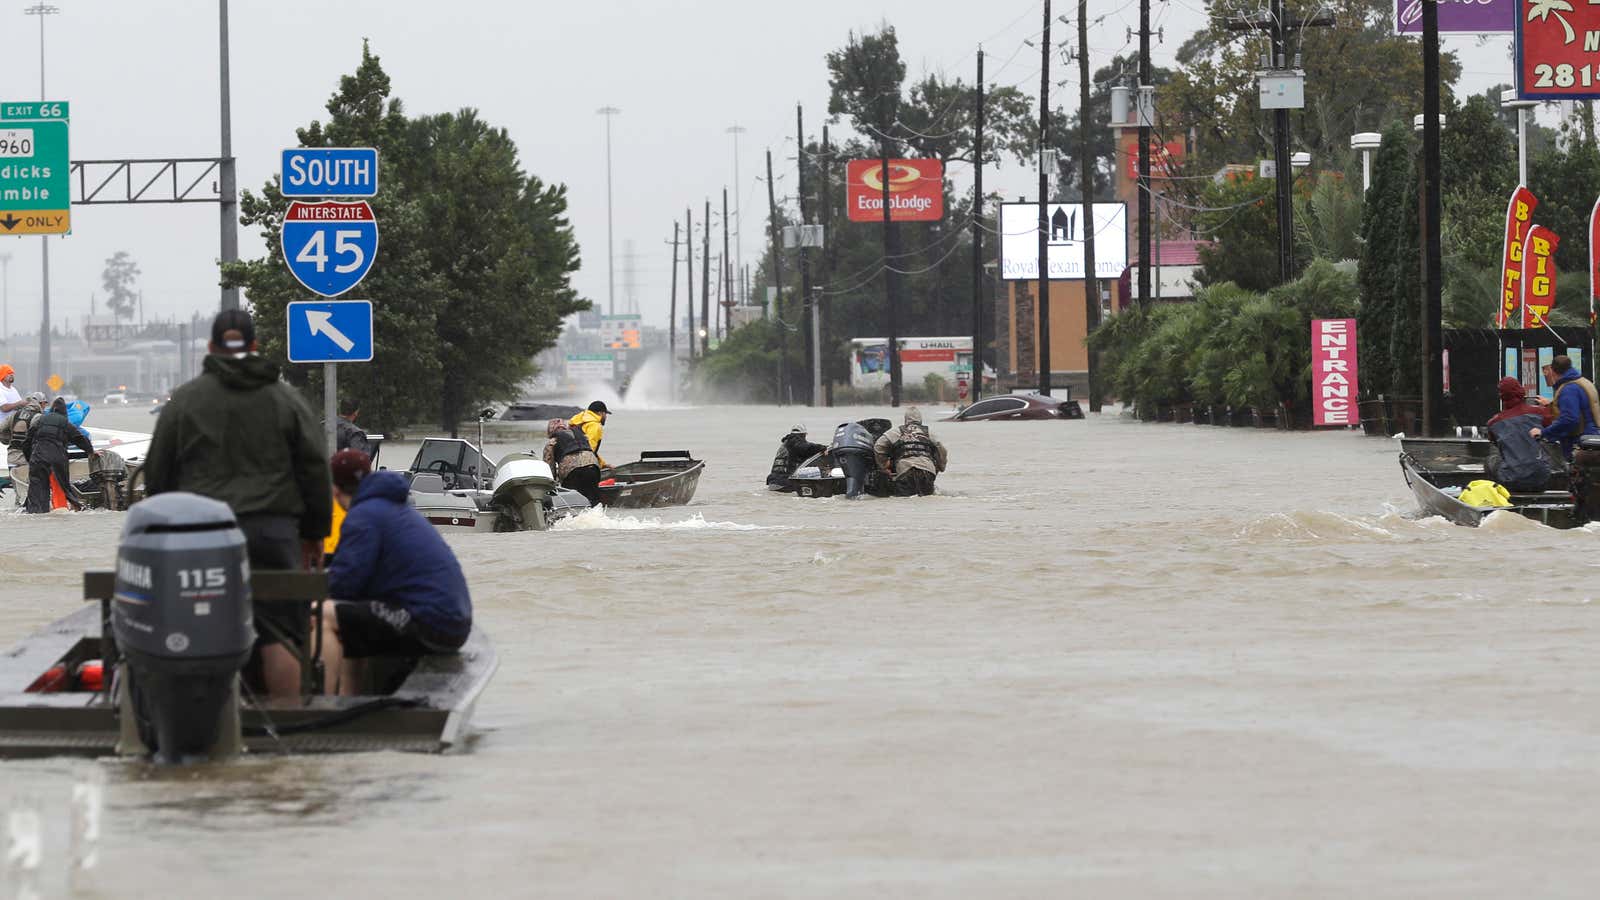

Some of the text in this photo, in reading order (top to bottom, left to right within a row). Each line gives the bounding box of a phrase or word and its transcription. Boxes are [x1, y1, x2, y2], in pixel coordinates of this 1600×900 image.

[7, 103, 62, 117] EXIT 66
[0, 139, 31, 154] 960
[1, 165, 51, 179] dicks
[289, 155, 370, 186] SOUTH
[0, 186, 50, 200] mble
[297, 207, 364, 219] INTERSTATE
[26, 216, 63, 227] ONLY
[1509, 199, 1529, 262] BIG
[295, 230, 365, 274] 45
[1046, 257, 1079, 273] exan
[1532, 235, 1551, 297] BIG
[1321, 321, 1349, 424] ENTRANCE
[177, 567, 226, 589] 115
